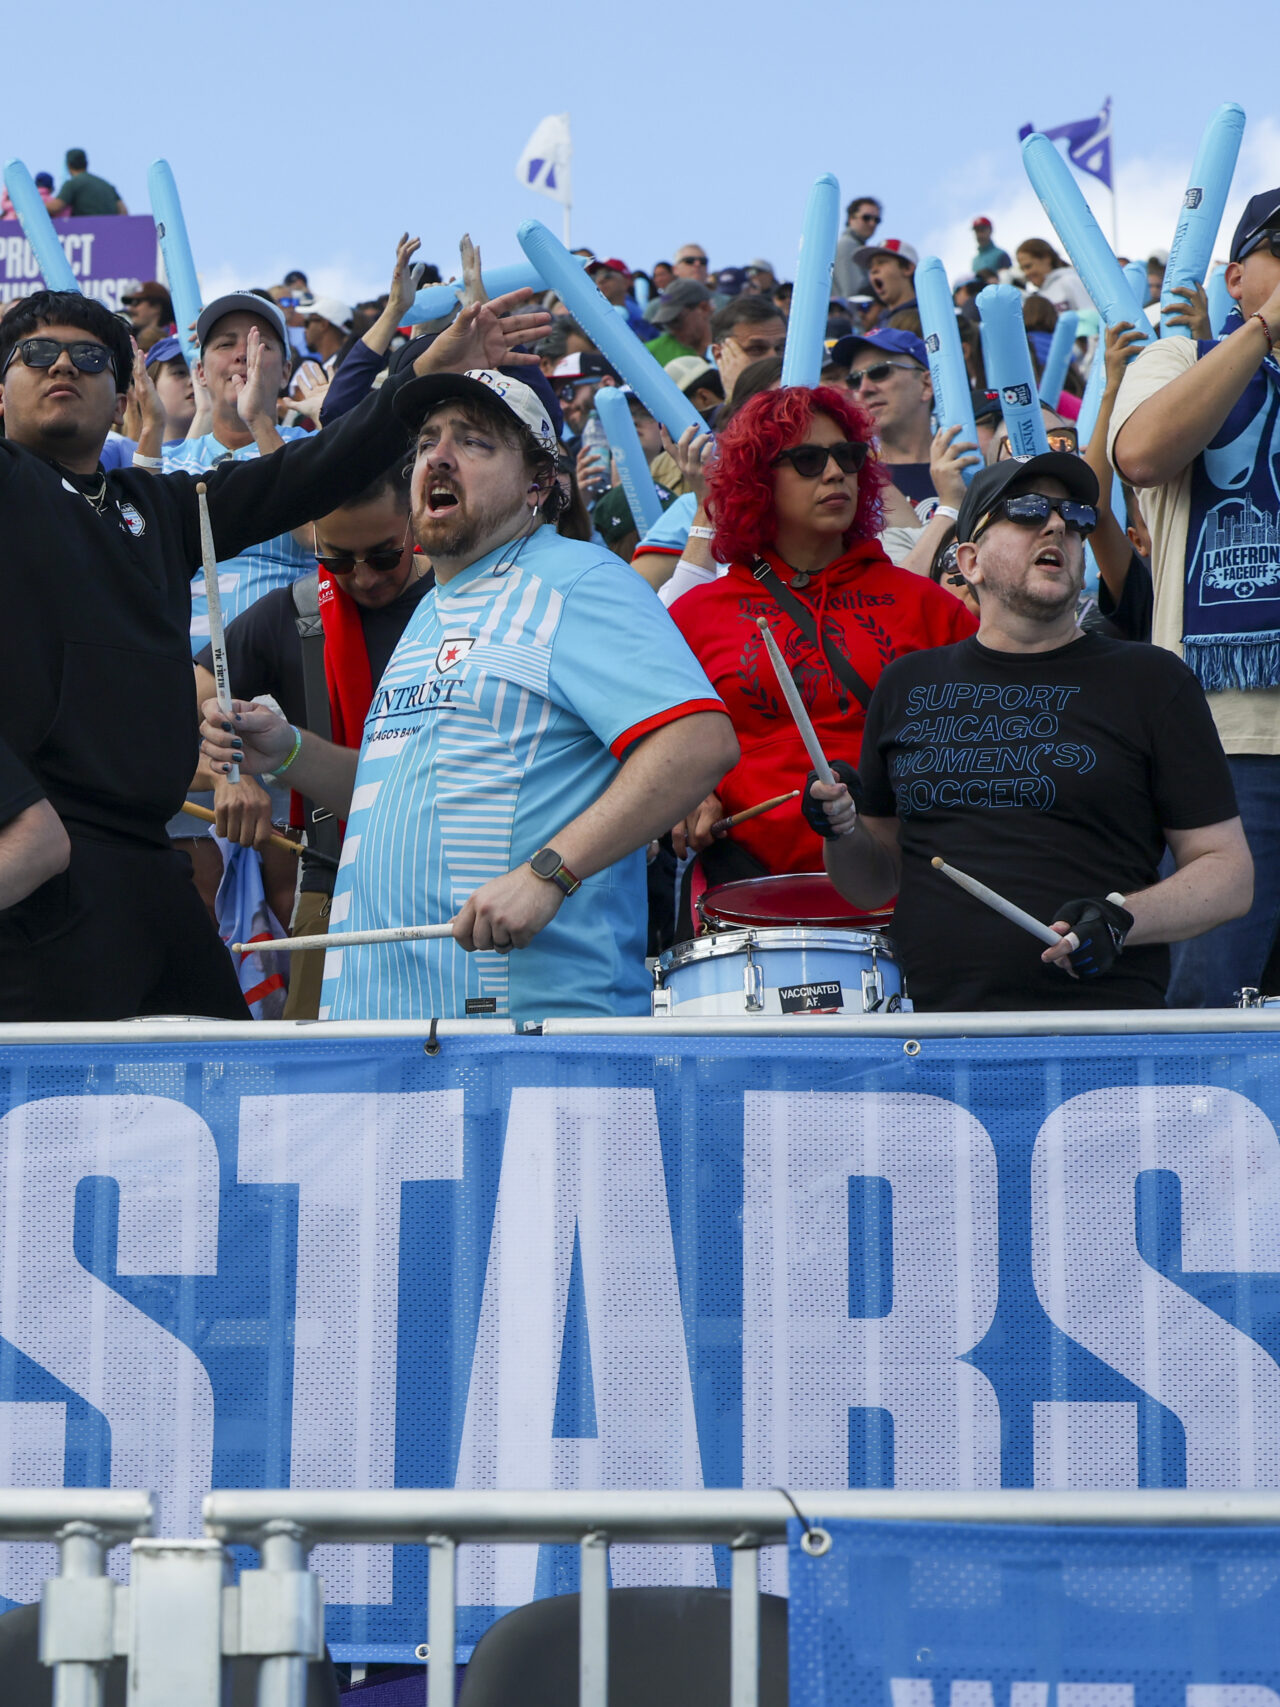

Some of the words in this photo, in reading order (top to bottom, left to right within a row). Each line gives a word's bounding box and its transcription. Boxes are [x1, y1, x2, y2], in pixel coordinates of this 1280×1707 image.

[1022, 418, 1036, 456] WINT
[1205, 545, 1280, 572] LAKEFRON
[1224, 564, 1268, 581] FACEOFF
[369, 679, 465, 715] INTRUST
[905, 682, 1080, 716] SUPPORT
[895, 712, 1059, 744] CHICAGO
[780, 984, 840, 1000] VACCINATED
[805, 998, 821, 1007] AF.
